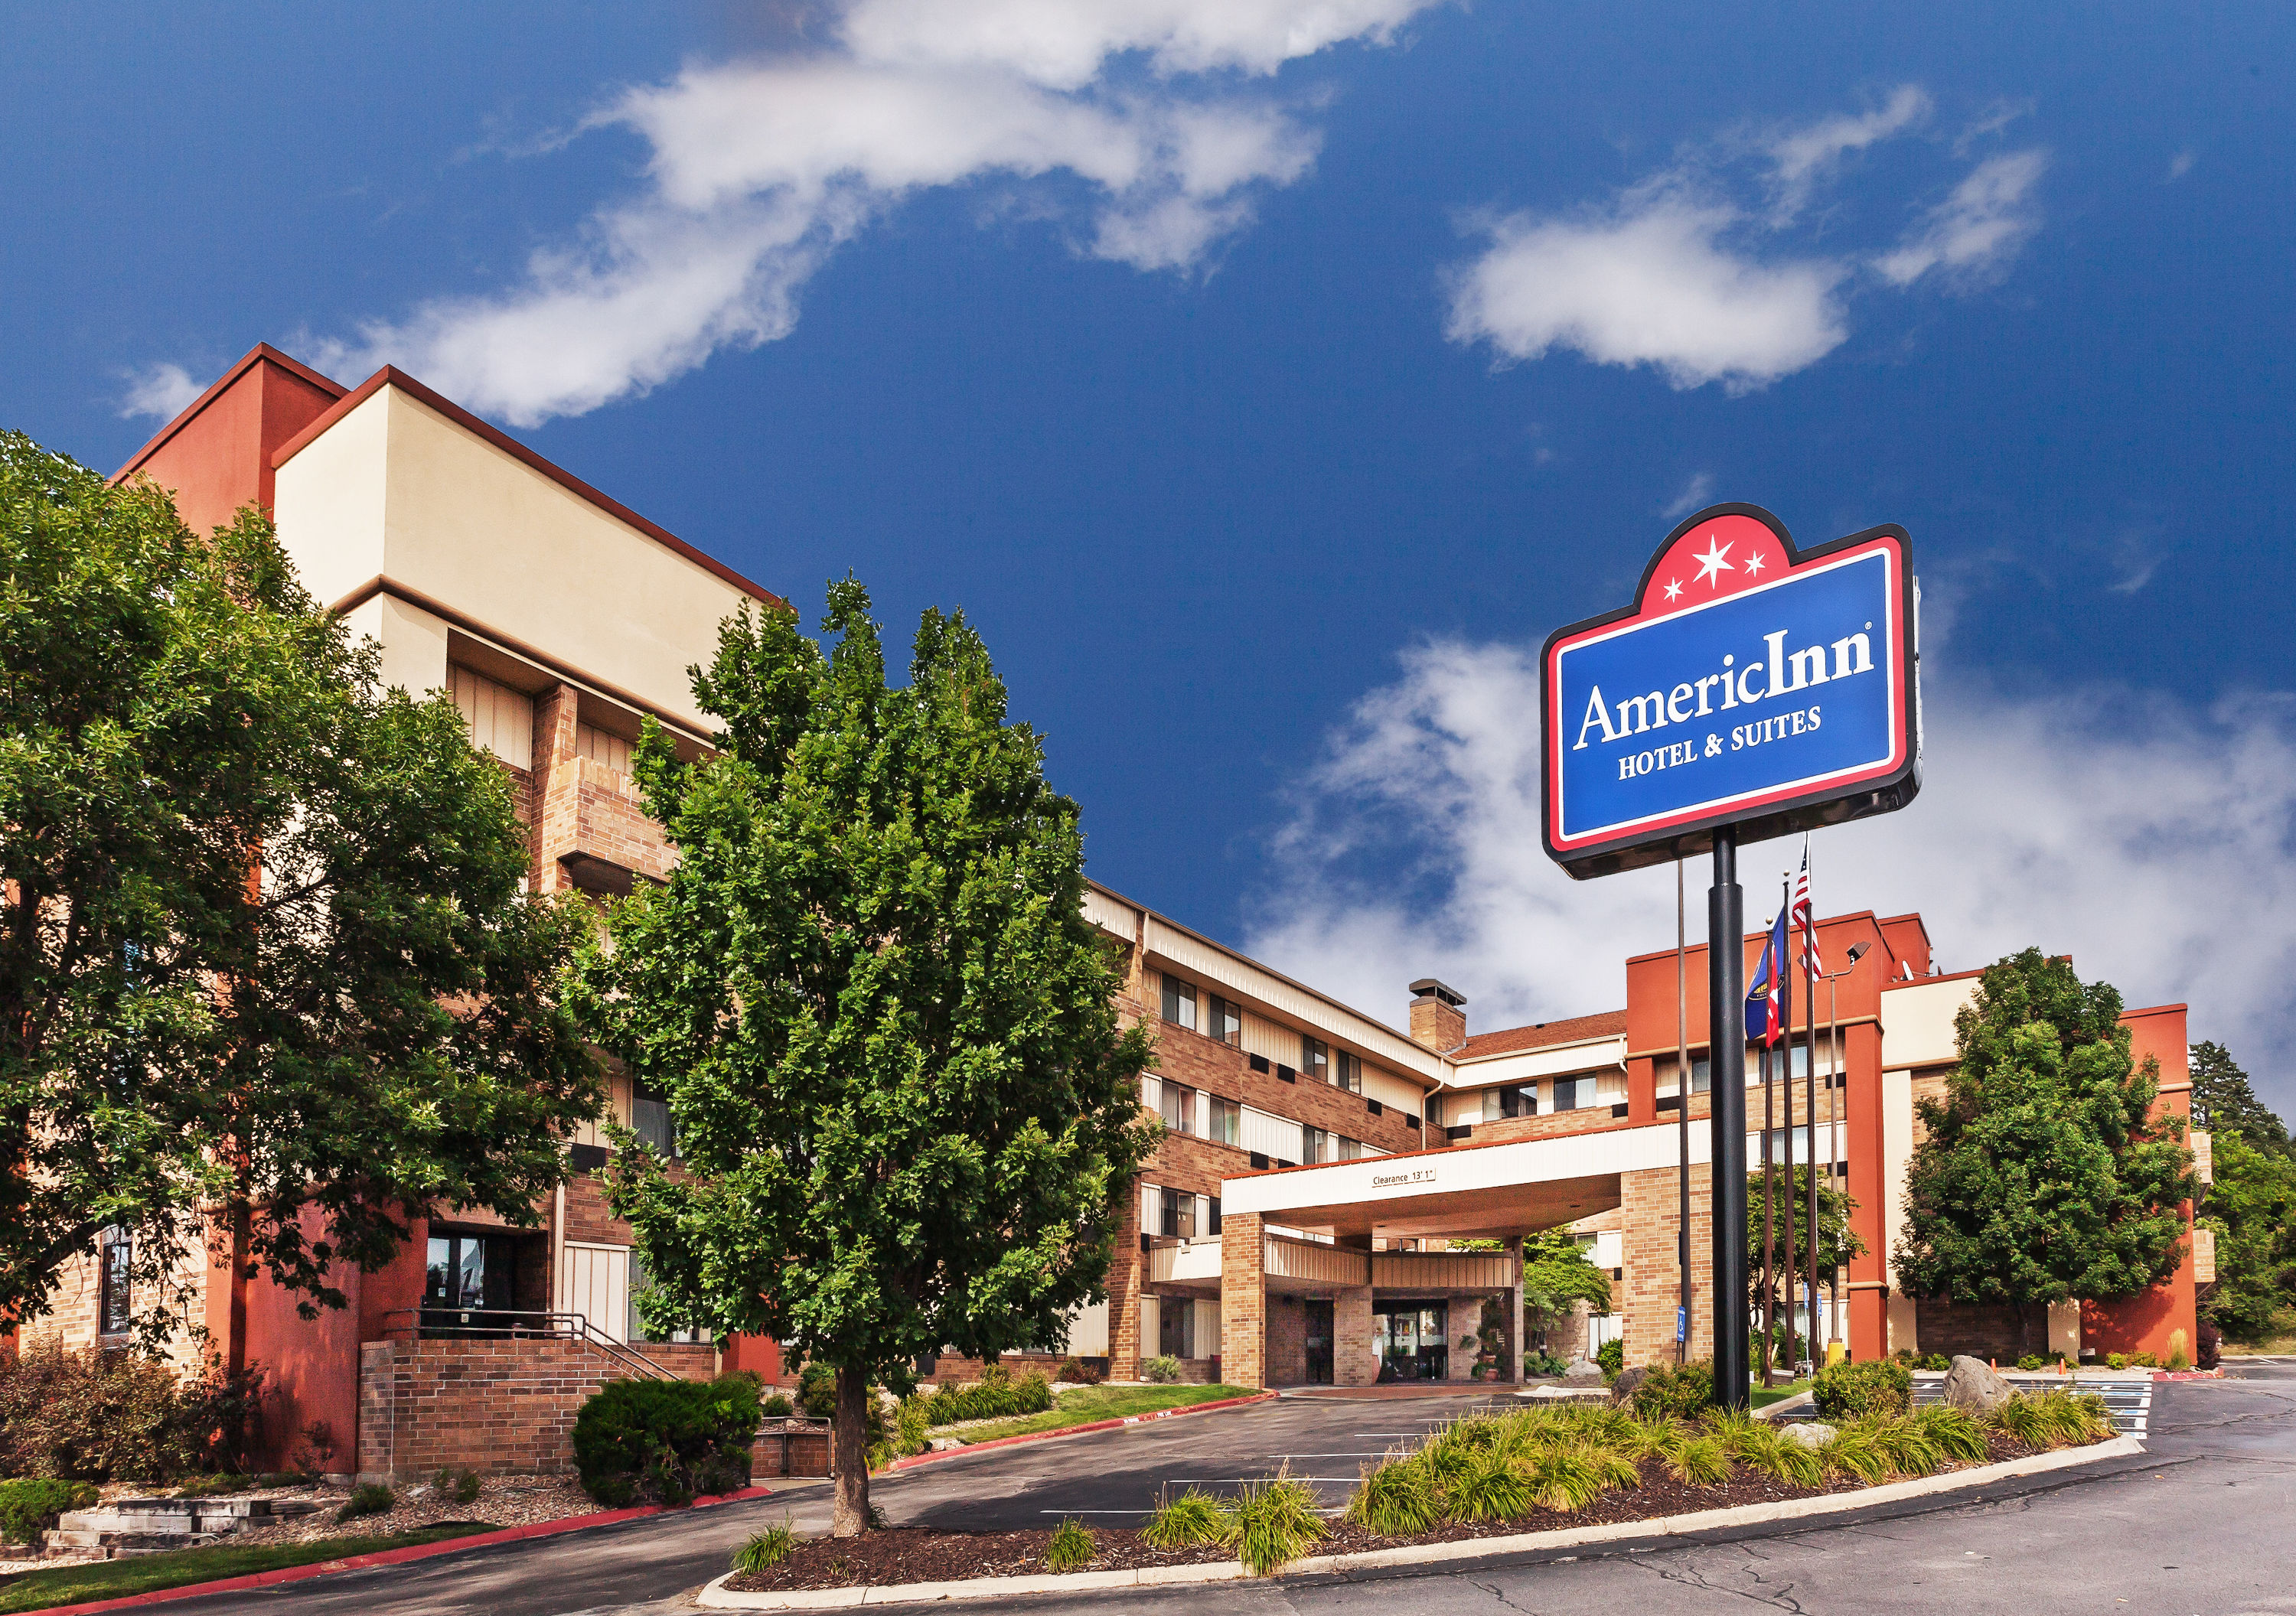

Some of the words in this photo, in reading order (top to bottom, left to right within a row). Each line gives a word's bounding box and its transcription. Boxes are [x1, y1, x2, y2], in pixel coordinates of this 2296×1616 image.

[1573, 629, 1874, 751] AmericInn
[1618, 741, 1698, 780] HOTEL
[1704, 733, 1724, 758] &
[1730, 705, 1821, 751] SUITES
[1373, 1175, 1408, 1185] Clearance
